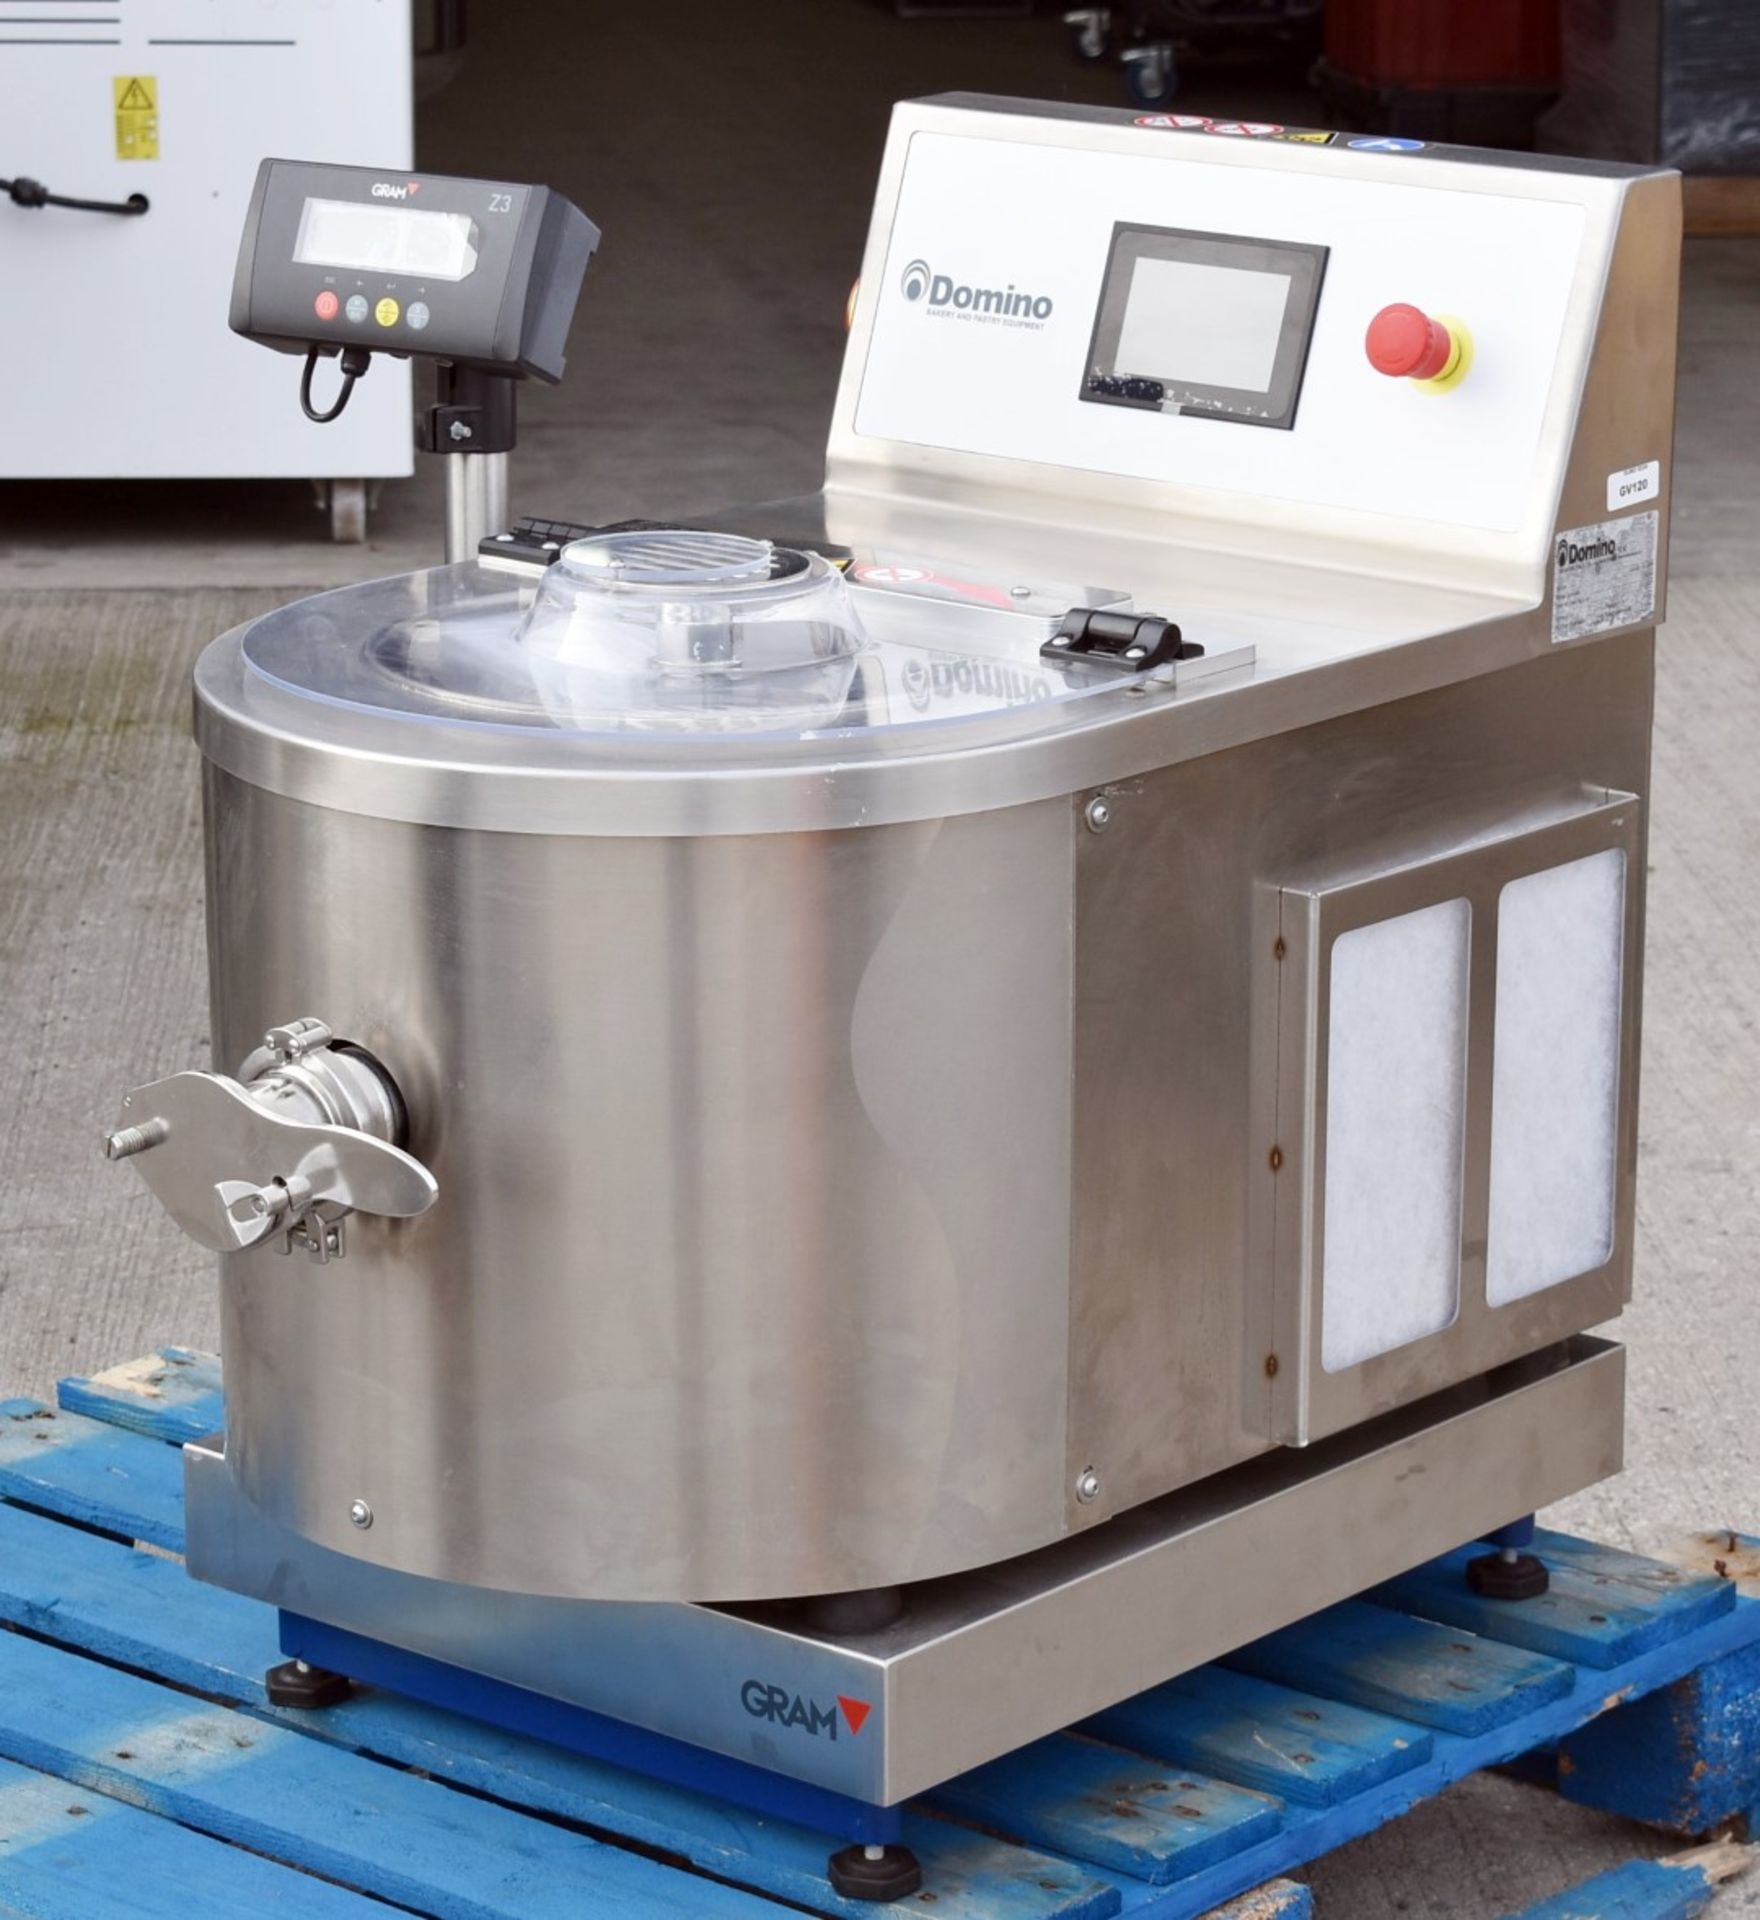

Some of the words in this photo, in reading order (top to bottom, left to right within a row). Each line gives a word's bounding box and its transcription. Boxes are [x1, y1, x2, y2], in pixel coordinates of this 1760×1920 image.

[371, 182, 407, 199] GRAM
[488, 193, 512, 213] Z3
[929, 275, 1053, 319] Domino
[926, 308, 955, 318] BAKERY
[956, 312, 972, 320] AND
[973, 314, 1001, 325] PASTRY
[1619, 478, 1649, 497] GV120
[1569, 537, 1615, 564] Domino
[741, 1679, 838, 1741] GRAM
